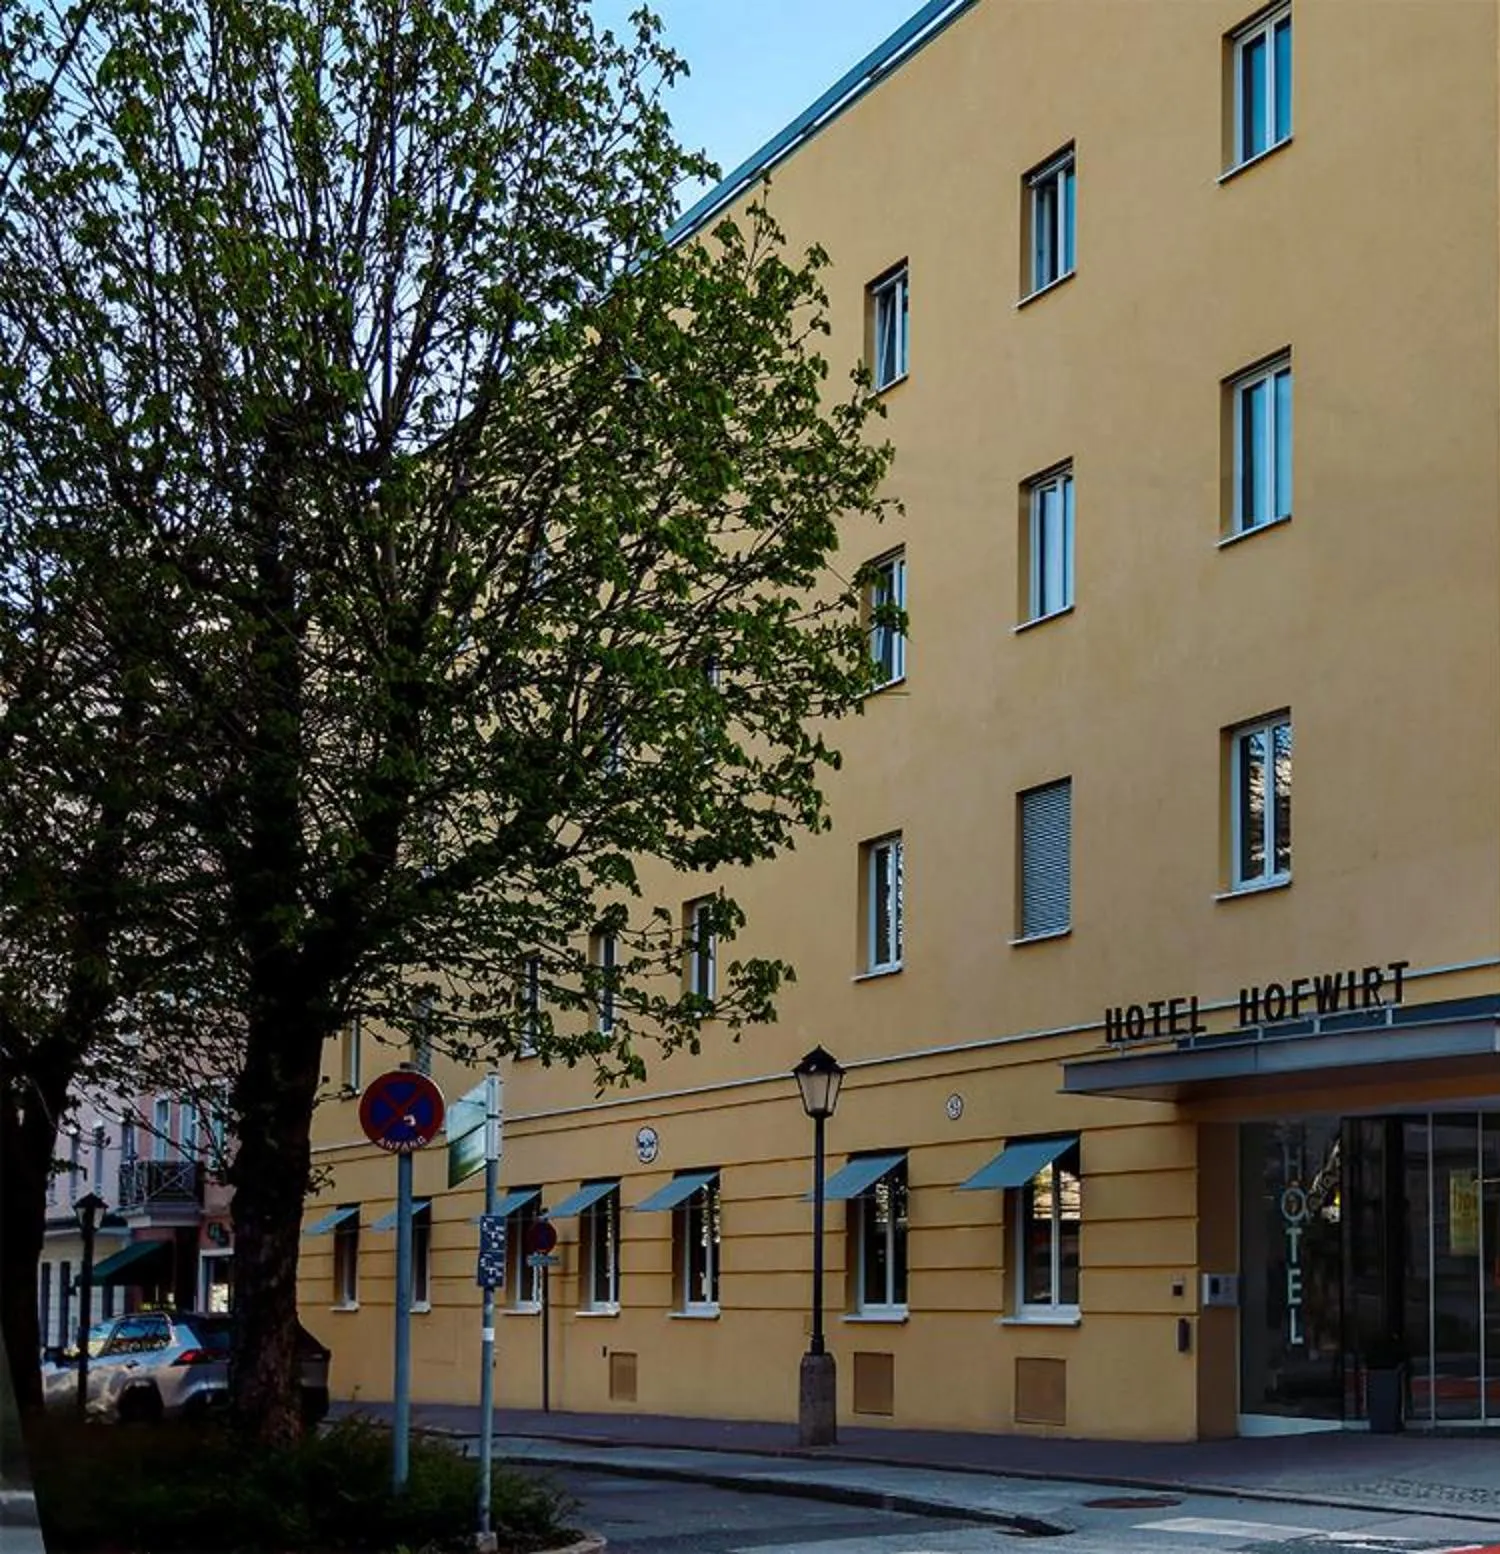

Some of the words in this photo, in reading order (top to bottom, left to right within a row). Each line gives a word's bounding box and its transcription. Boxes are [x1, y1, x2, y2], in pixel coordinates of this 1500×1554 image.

[1105, 996, 1206, 1043] HOTEL
[1239, 961, 1409, 1027] HOFWIRT
[378, 1136, 427, 1152] ANFANG
[1281, 1142, 1307, 1345] HOTEL
